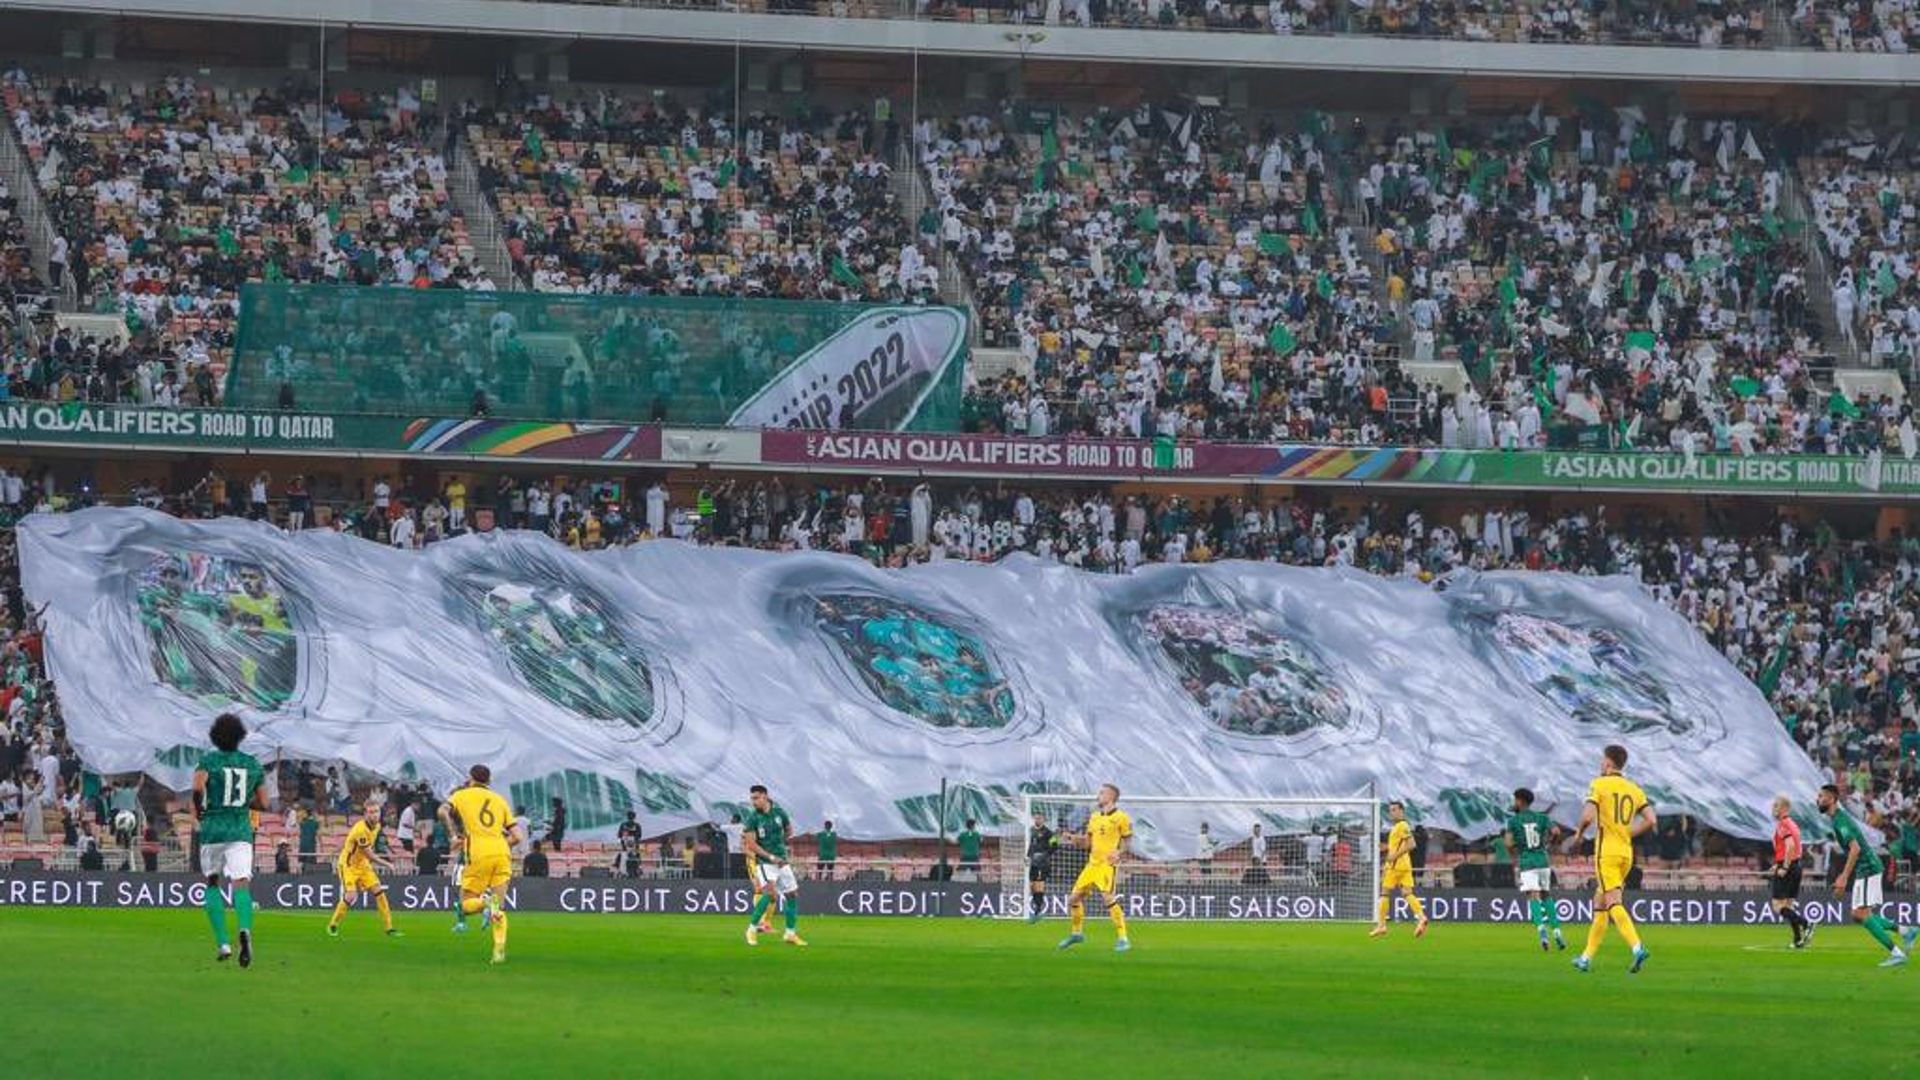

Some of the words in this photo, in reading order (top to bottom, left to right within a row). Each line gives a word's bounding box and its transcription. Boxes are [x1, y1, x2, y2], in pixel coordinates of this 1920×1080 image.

[838, 332, 910, 415] 2022
[202, 413, 247, 437] ROAD
[252, 415, 273, 438] TO
[279, 415, 334, 440] QATAR
[817, 436, 900, 460] ASIAN
[907, 438, 1062, 466] QUALIFIERS
[1067, 444, 1111, 468] ROAD
[1115, 446, 1136, 469] TO
[1142, 447, 1194, 470] QAR
[1554, 456, 1636, 479] ASIAN
[1641, 458, 1792, 483] QUALIFIERS
[1797, 461, 1840, 483] ROAD
[222, 766, 247, 807] 13
[479, 798, 495, 828] 6
[1612, 792, 1634, 826] 10
[0, 880, 104, 905] REDIT
[402, 885, 517, 909] SAIN
[560, 887, 672, 912] CREDIT
[684, 888, 785, 912] SAIS
[838, 890, 946, 914] CREDIT
[1229, 895, 1335, 918] SAISON
[1490, 898, 1593, 921] SAION
[1632, 899, 1732, 923] CREDIT
[1880, 901, 1920, 923] CR
